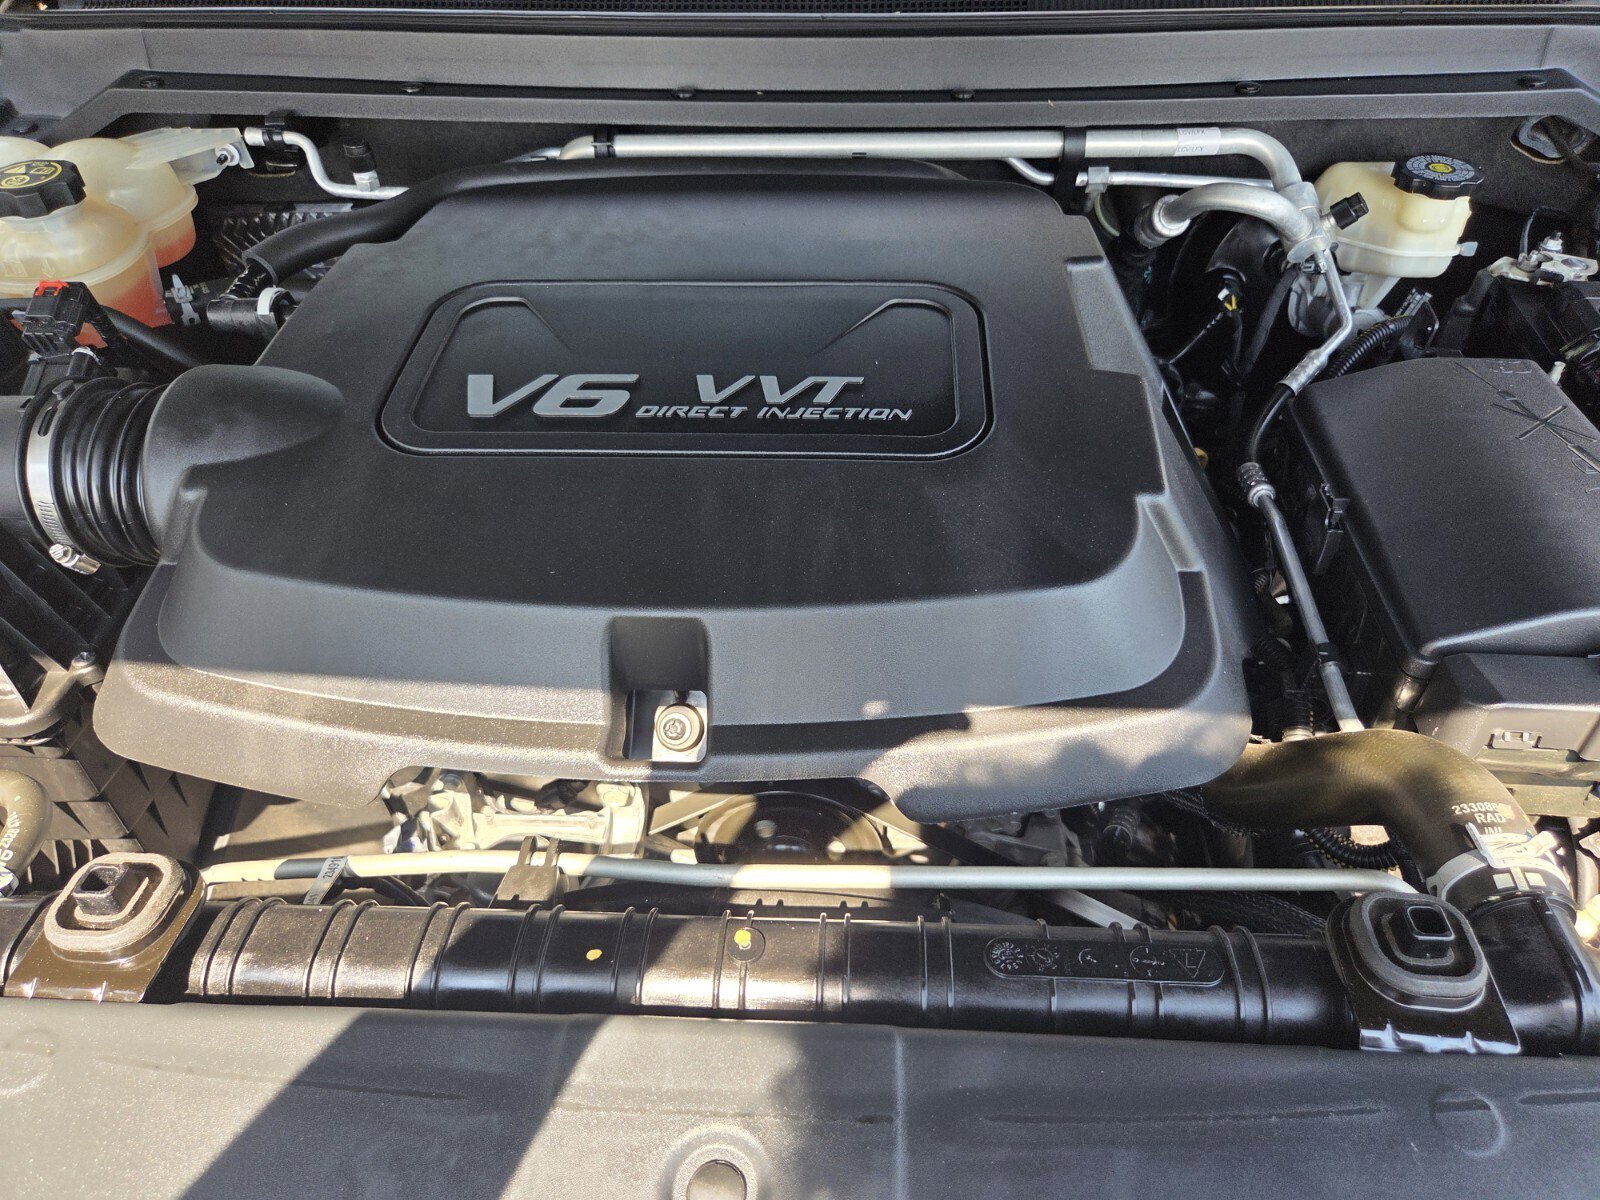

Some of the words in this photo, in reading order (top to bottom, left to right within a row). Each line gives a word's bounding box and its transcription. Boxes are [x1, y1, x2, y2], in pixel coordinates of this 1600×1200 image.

[467, 374, 640, 417] V6
[696, 374, 865, 405] VVT
[635, 405, 749, 419] DIRECT
[756, 406, 913, 421] INJECTION
[1475, 813, 1506, 823] RAD
